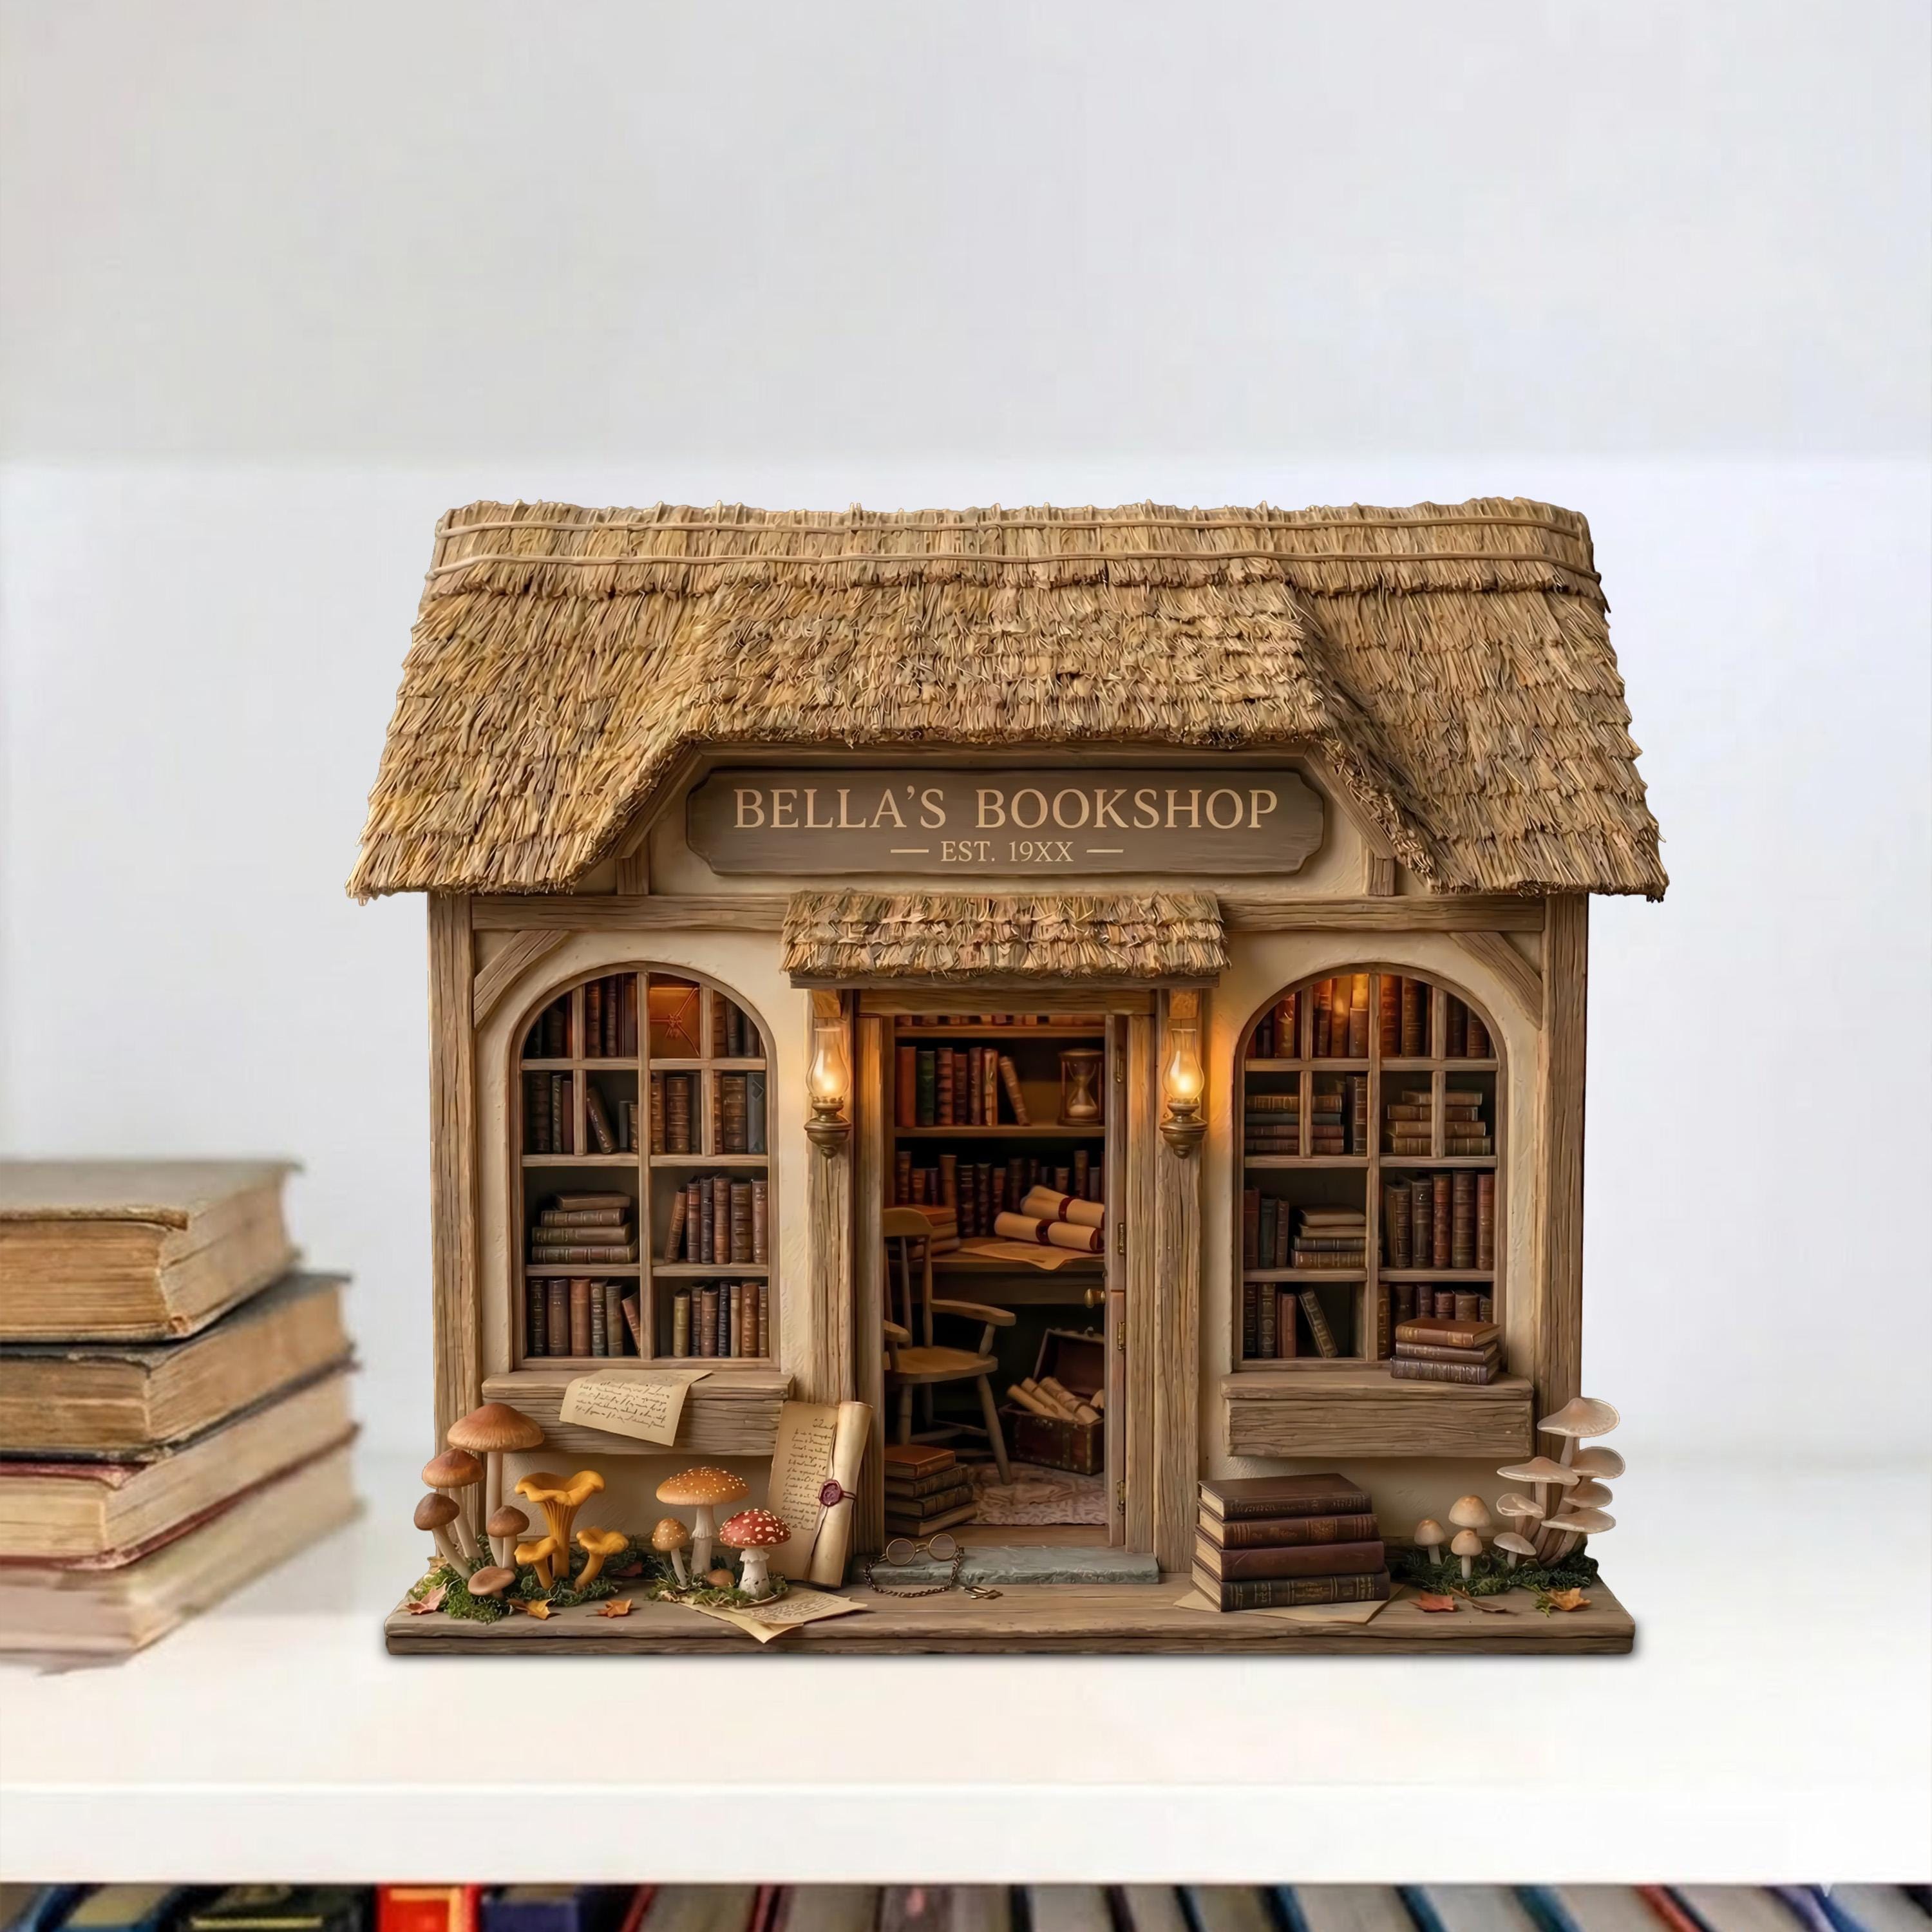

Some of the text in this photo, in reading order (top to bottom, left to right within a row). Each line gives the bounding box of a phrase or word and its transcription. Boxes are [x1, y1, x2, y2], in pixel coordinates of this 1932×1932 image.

[734, 785, 1278, 829] BELLA’S BOOKSHOP
[940, 840, 1074, 862] EST. 19XX
